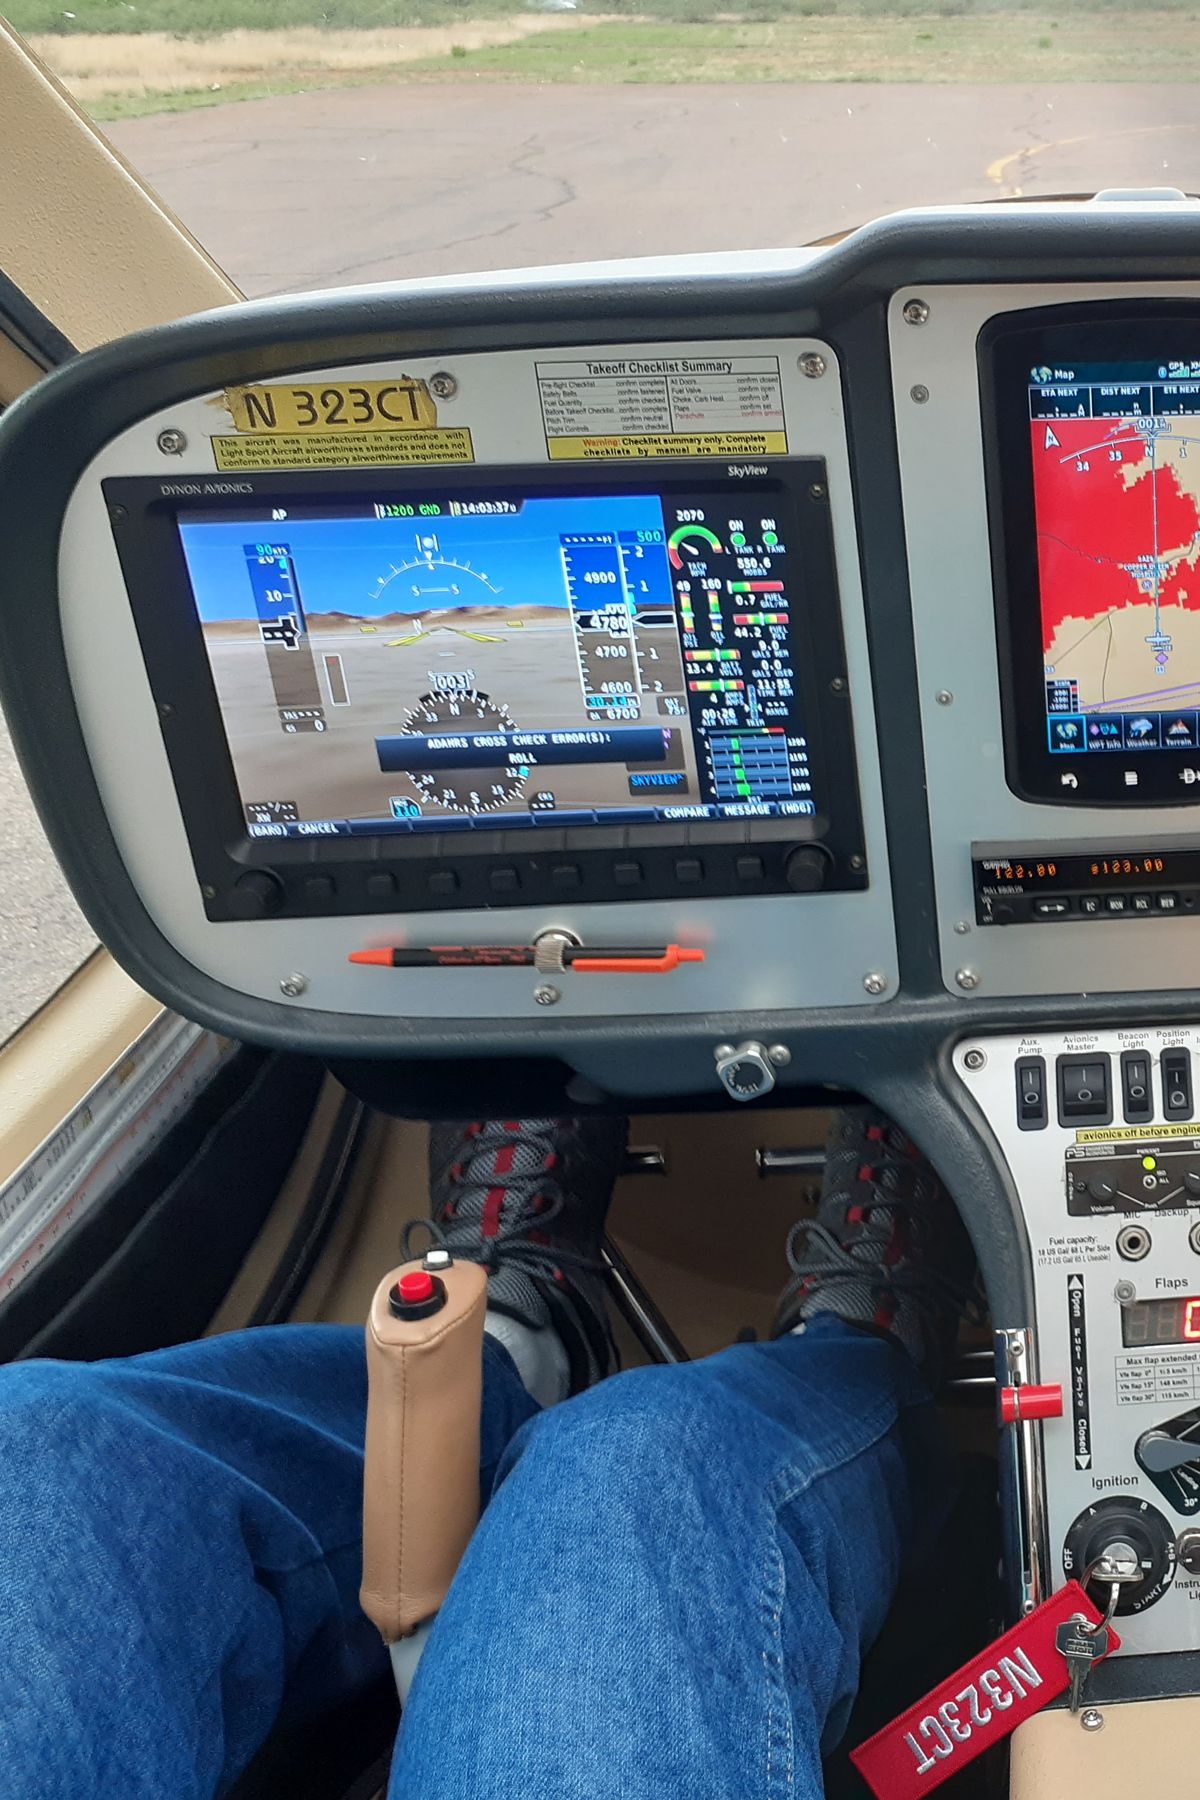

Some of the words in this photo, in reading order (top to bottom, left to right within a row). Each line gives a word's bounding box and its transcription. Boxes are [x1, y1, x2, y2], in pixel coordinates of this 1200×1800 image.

[586, 363, 626, 375] Takeoff
[629, 361, 679, 373] Checklist
[682, 360, 732, 374] Summary
[1055, 369, 1074, 381] Map
[245, 392, 277, 428] N
[292, 386, 421, 427] 323CT
[245, 437, 276, 446] aircraft
[308, 433, 367, 445] manufactured
[390, 433, 438, 442] accordance
[446, 432, 464, 440] with
[583, 437, 621, 449] Warning:
[622, 435, 662, 446] Checklist
[663, 435, 702, 447] summary
[726, 433, 766, 445] Complete
[221, 447, 242, 458] Light
[246, 447, 269, 457] Sport
[271, 445, 303, 455] Aircraft
[306, 443, 362, 454] airworthiness
[366, 443, 408, 453] standards
[411, 441, 426, 450] and
[429, 441, 449, 450] does
[452, 441, 465, 449] not
[728, 465, 768, 478] SkyView
[160, 484, 201, 495] DYNON
[205, 483, 253, 494] AVIONICS
[637, 530, 661, 543] 500
[584, 571, 616, 584] 4900
[595, 646, 627, 658] 4700
[601, 682, 632, 693] 4600
[473, 735, 507, 747] CROSS
[512, 734, 547, 746] CHECK
[509, 753, 537, 764] ROLL
[1064, 1034, 1098, 1044] Avionics
[1117, 1031, 1149, 1040] Beacon
[1156, 1029, 1190, 1039] Position
[1021, 1038, 1040, 1047] Aux.
[1067, 1042, 1095, 1051] Master
[1123, 1039, 1144, 1049] Light
[1163, 1037, 1184, 1046] Light
[1018, 1046, 1043, 1056] Pump
[1084, 1130, 1123, 1140] avionics
[1125, 1129, 1137, 1138] off
[1139, 1127, 1169, 1137] before
[1155, 1277, 1188, 1289] Flaps
[1092, 1475, 1138, 1489] Ignition
[1064, 1548, 1073, 1570] OFF
[1133, 1584, 1164, 1609] START
[903, 1647, 1043, 1774] N323CT
